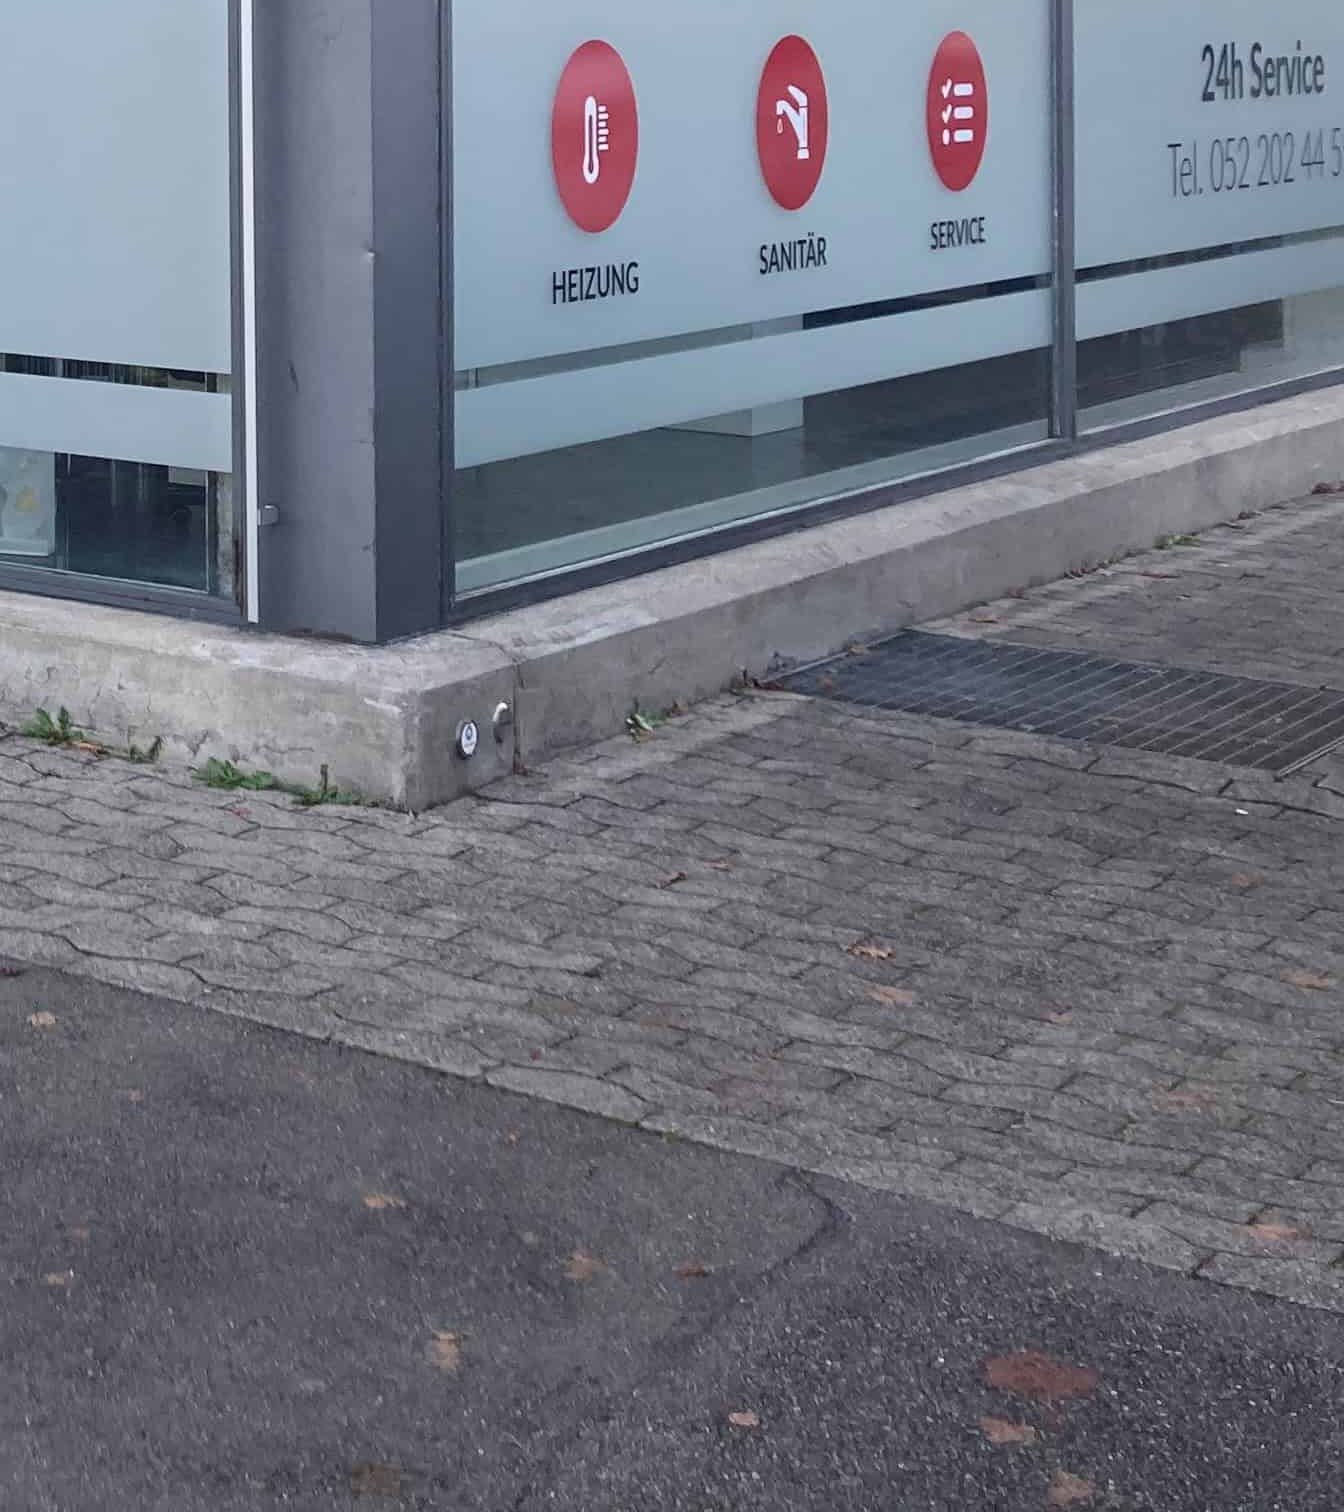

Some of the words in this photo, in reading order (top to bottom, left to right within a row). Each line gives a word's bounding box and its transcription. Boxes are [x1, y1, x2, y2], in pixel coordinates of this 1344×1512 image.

[1201, 41, 1244, 103] 24h
[1250, 39, 1325, 99] Service
[1167, 142, 1203, 197] Tel.
[1210, 136, 1250, 193] 052
[1257, 131, 1295, 186] 202
[1300, 128, 1325, 182] 44
[1331, 127, 1344, 177] 5
[759, 231, 827, 275] SANITÄR
[930, 216, 986, 250] SERVICE
[551, 261, 640, 305] HEIZUNG
